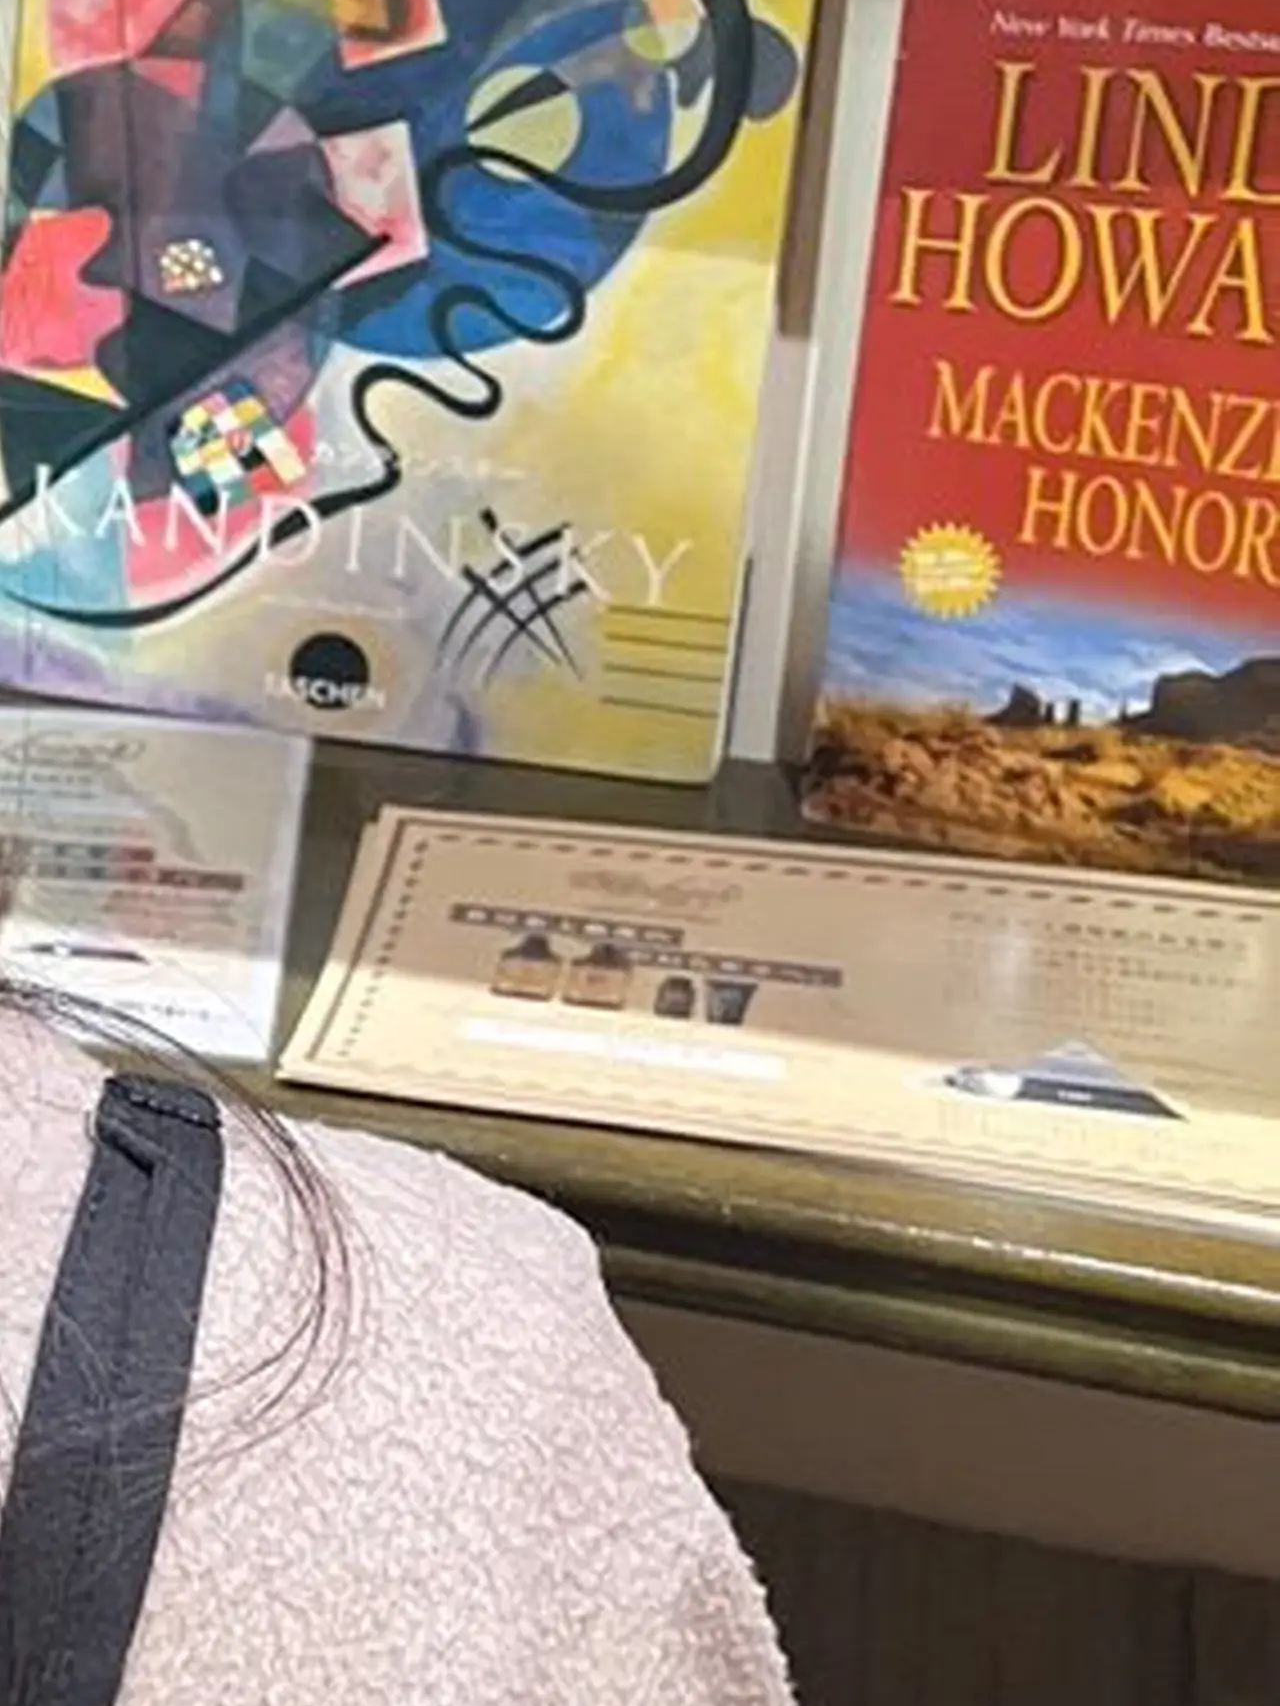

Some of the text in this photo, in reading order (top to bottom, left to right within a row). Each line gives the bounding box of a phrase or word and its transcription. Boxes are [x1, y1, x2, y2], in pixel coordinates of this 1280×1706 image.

[990, 10, 1052, 38] New
[1057, 14, 1111, 40] York
[1123, 17, 1196, 44] Times
[888, 186, 1280, 343] HOWA
[28, 463, 693, 607] KANDINSKY
[1018, 465, 1280, 587] HONOR
